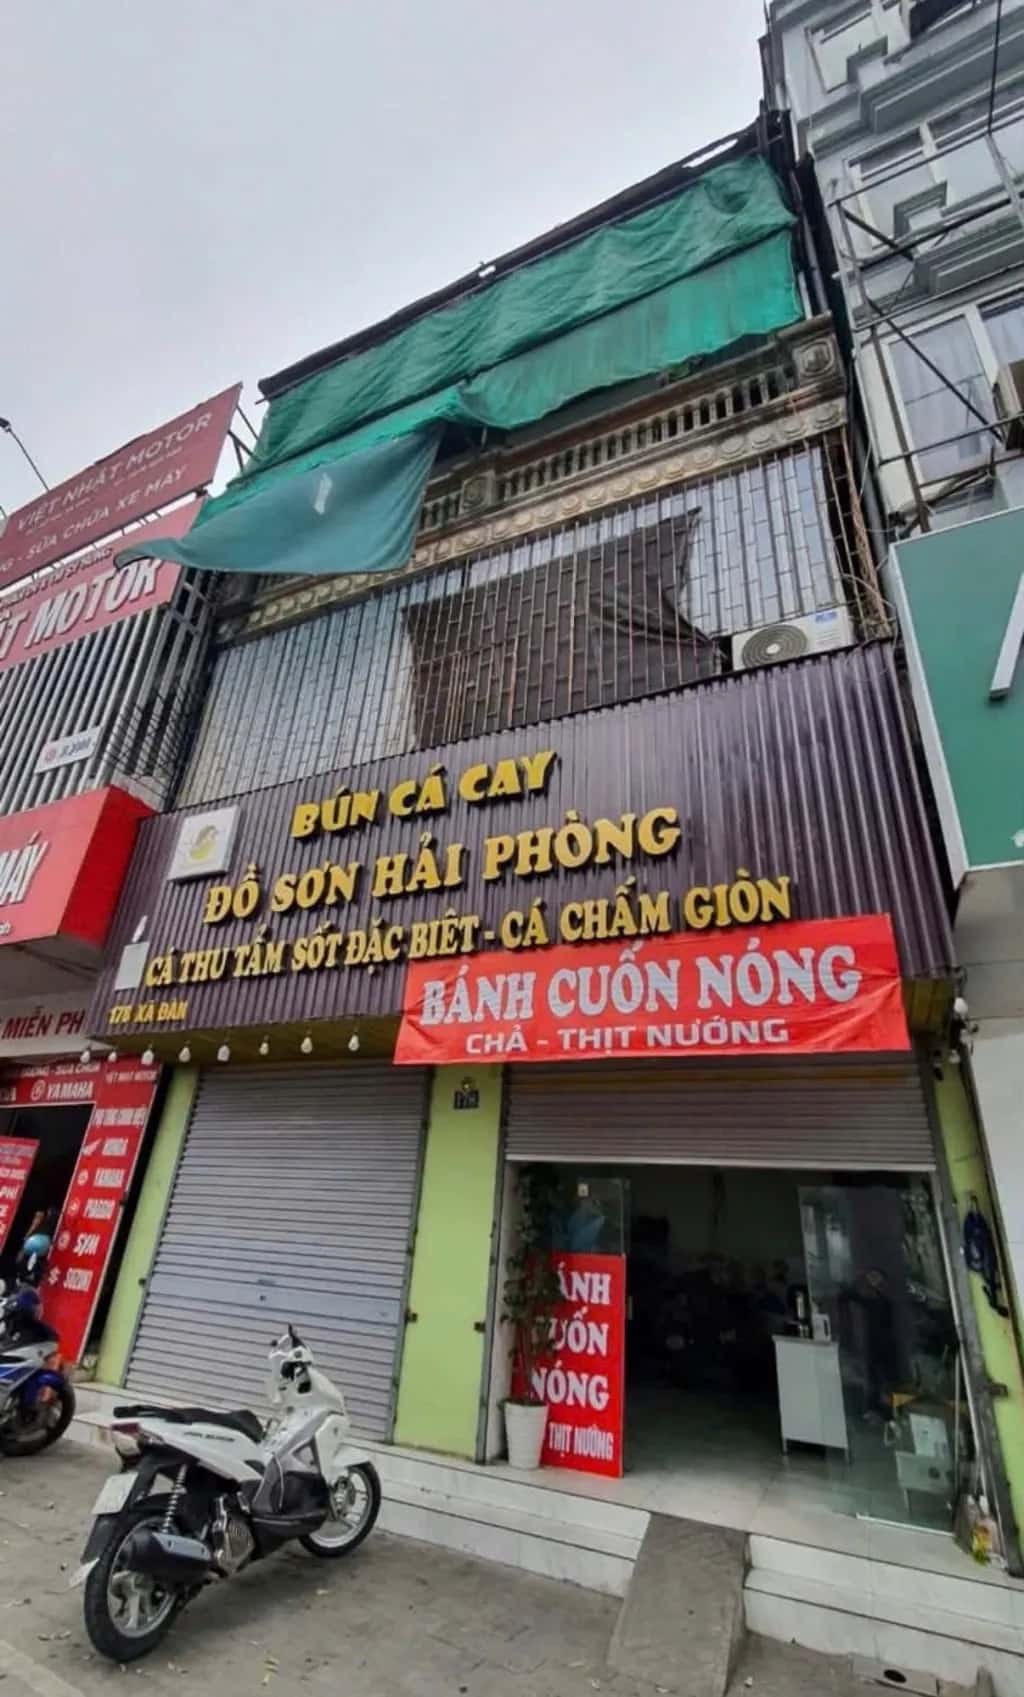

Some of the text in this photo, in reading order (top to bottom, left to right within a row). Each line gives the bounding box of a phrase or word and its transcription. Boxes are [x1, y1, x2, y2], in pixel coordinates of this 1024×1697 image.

[126, 412, 212, 470] MOTOR
[115, 489, 142, 512] XE
[24, 556, 161, 648] MOTOR
[290, 751, 557, 840] BÚN CÁ CAY
[203, 807, 681, 924] ĐỒ SƠN HẢI PHÒNG
[145, 945, 176, 987] CÁ
[178, 950, 229, 984] THU
[292, 920, 342, 972] SỐT
[344, 916, 404, 975] ĐẶC
[501, 899, 549, 950] CÁ
[560, 876, 672, 942] CHẤM
[684, 868, 791, 930] GIÒN
[419, 937, 864, 1026] BÁNH CUỐN NÓNG
[55, 1010, 86, 1036] PH
[466, 1025, 528, 1055] CHẢ
[557, 1026, 637, 1055] THỊT
[647, 1015, 789, 1047] NƯỚNG
[47, 1080, 94, 1100] YAMAHA
[556, 1261, 611, 1305] ÁNH
[543, 1306, 609, 1357] UỐN
[530, 1360, 610, 1412] NÓNG
